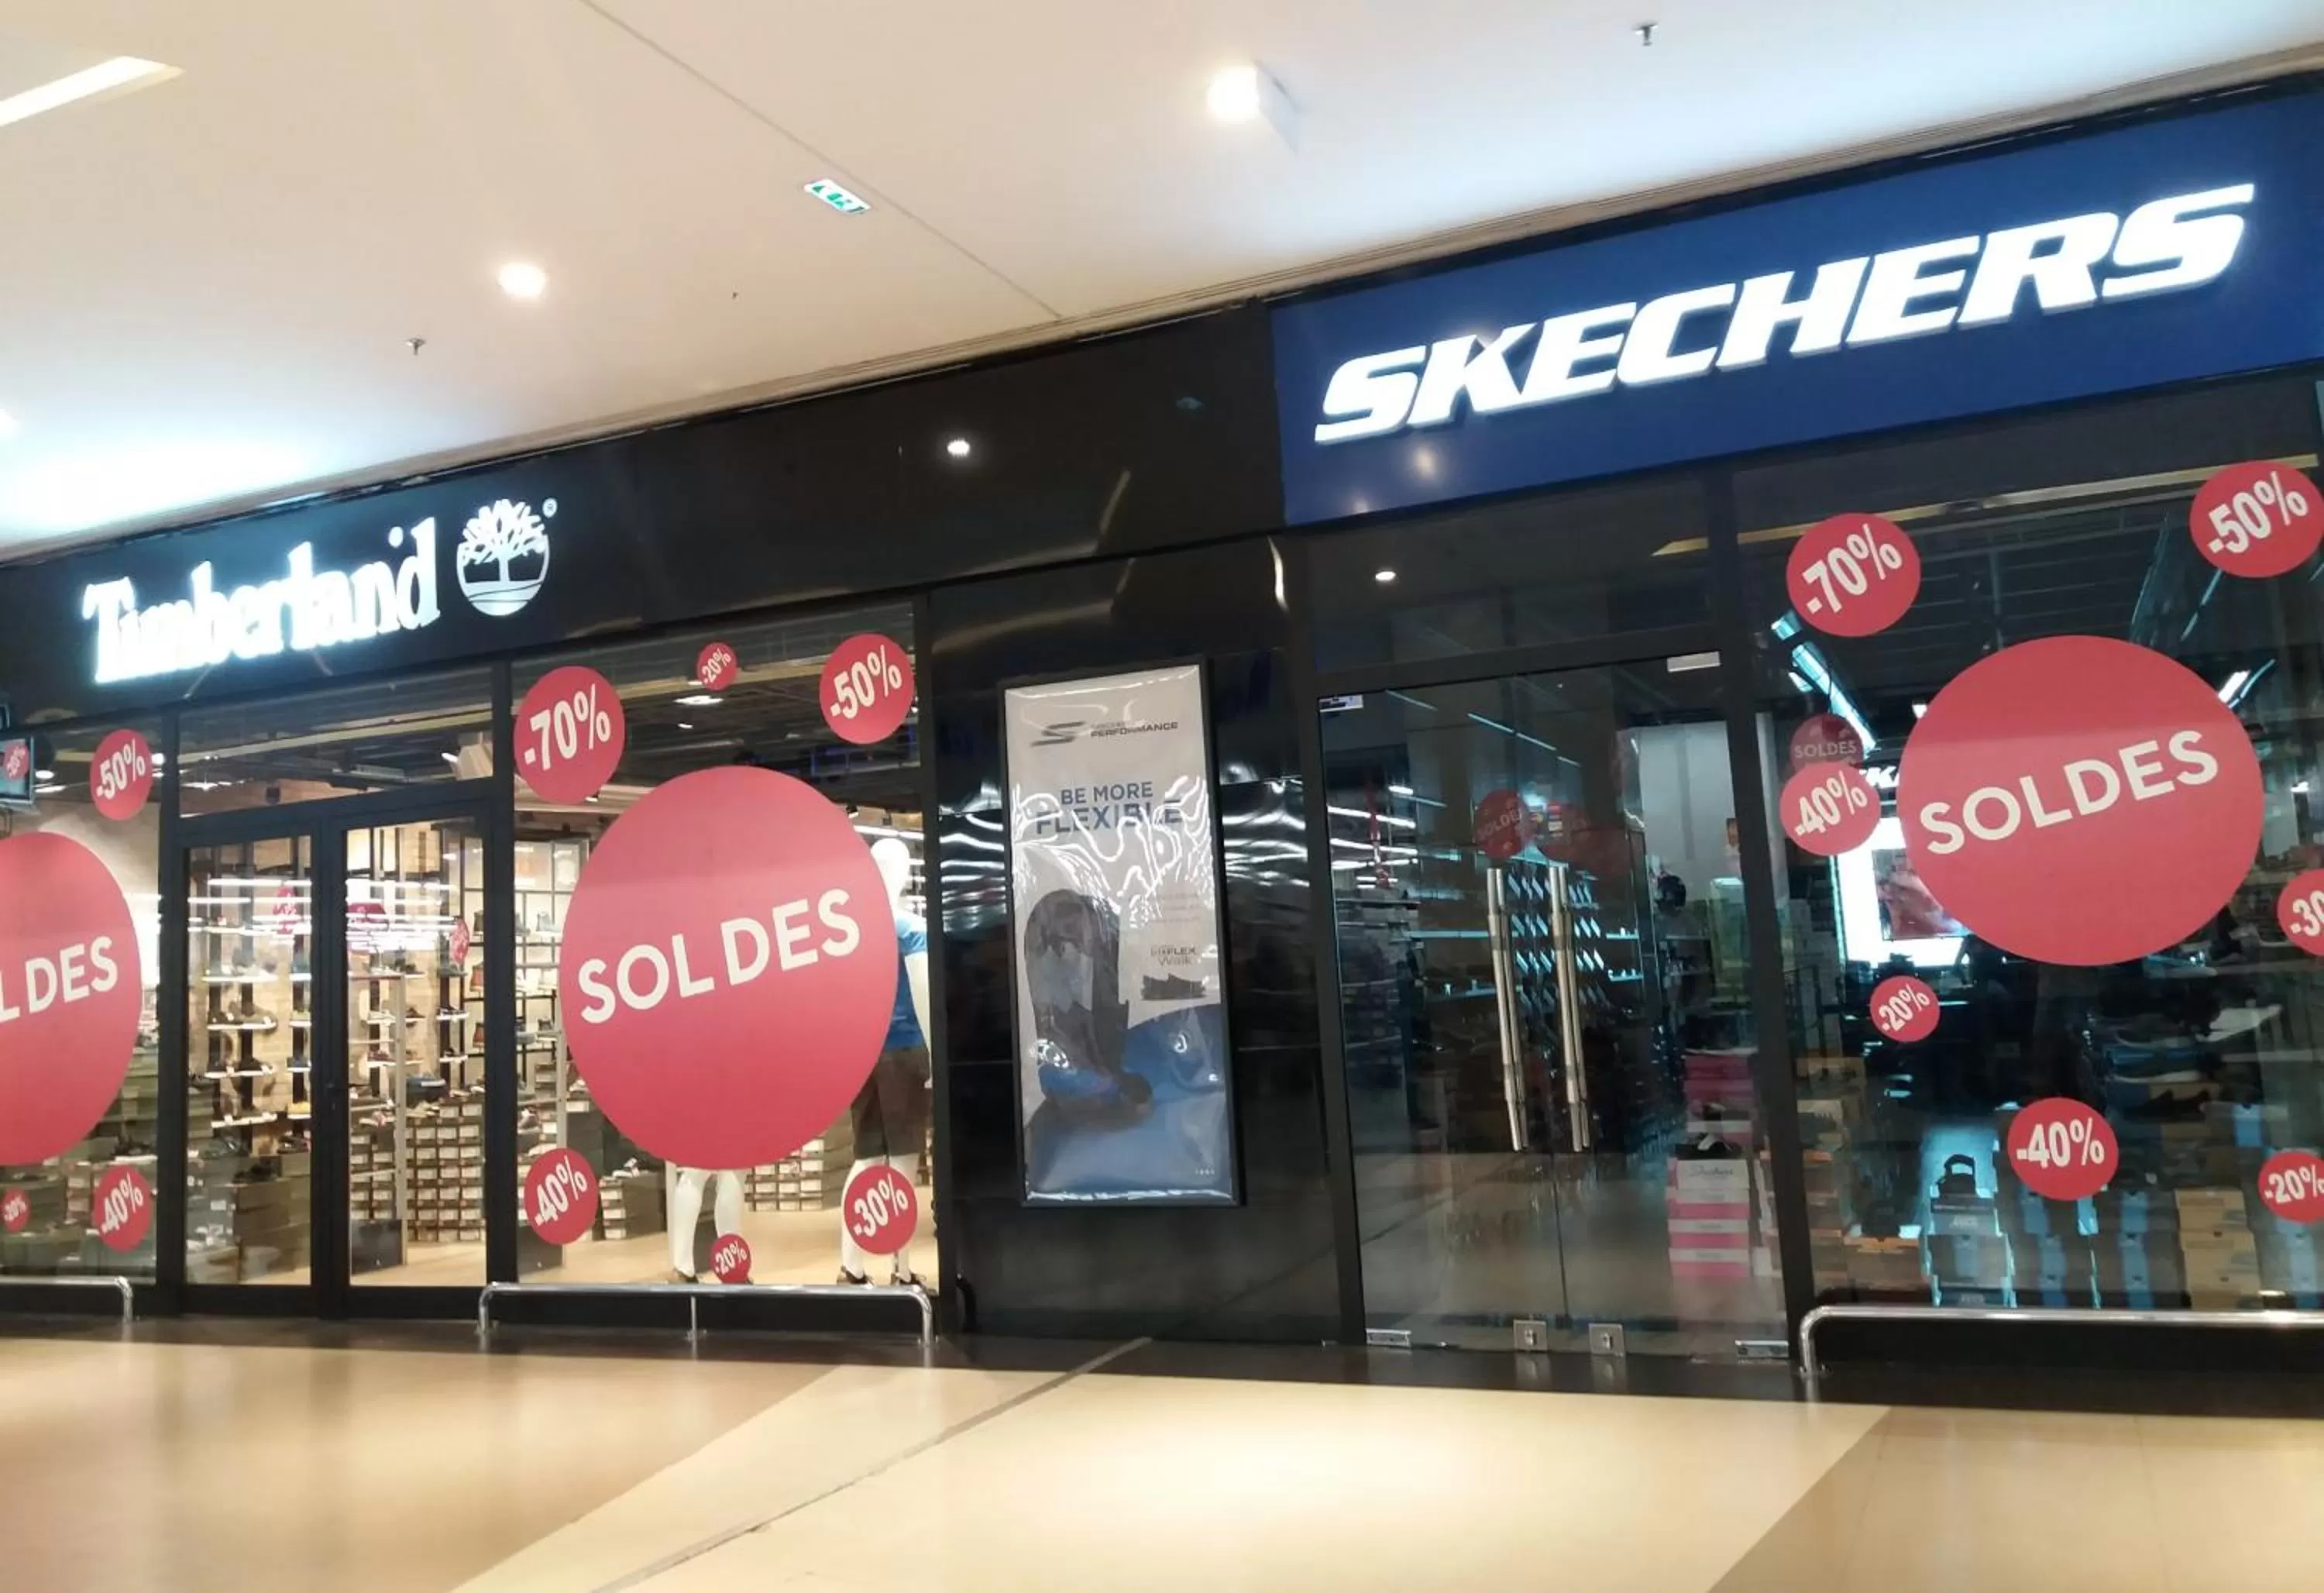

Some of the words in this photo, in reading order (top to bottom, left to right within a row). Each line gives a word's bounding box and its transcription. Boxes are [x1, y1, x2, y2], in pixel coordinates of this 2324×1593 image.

[1314, 183, 2255, 443] SKECHERS
[2208, 470, 2309, 554] -50%
[81, 516, 441, 684] Timberland
[1802, 522, 1903, 614] -70%
[701, 648, 732, 685] -20%
[830, 644, 902, 720] -50%
[523, 683, 611, 771] -70%
[1794, 741, 1857, 759] SOLDES
[96, 738, 146, 800] -50%
[1061, 788, 1087, 805] BE
[1093, 781, 1153, 803] MORE
[1794, 769, 1868, 836] -40%
[1920, 730, 2219, 855] SOLDES
[577, 888, 861, 1024] SOLDES
[1879, 984, 1930, 1032] -20%
[2016, 1117, 2105, 1168] -40%
[101, 1172, 144, 1233] -40%
[534, 1156, 588, 1226] -40%
[853, 1173, 909, 1237] -30%
[715, 1240, 748, 1275] -20%
